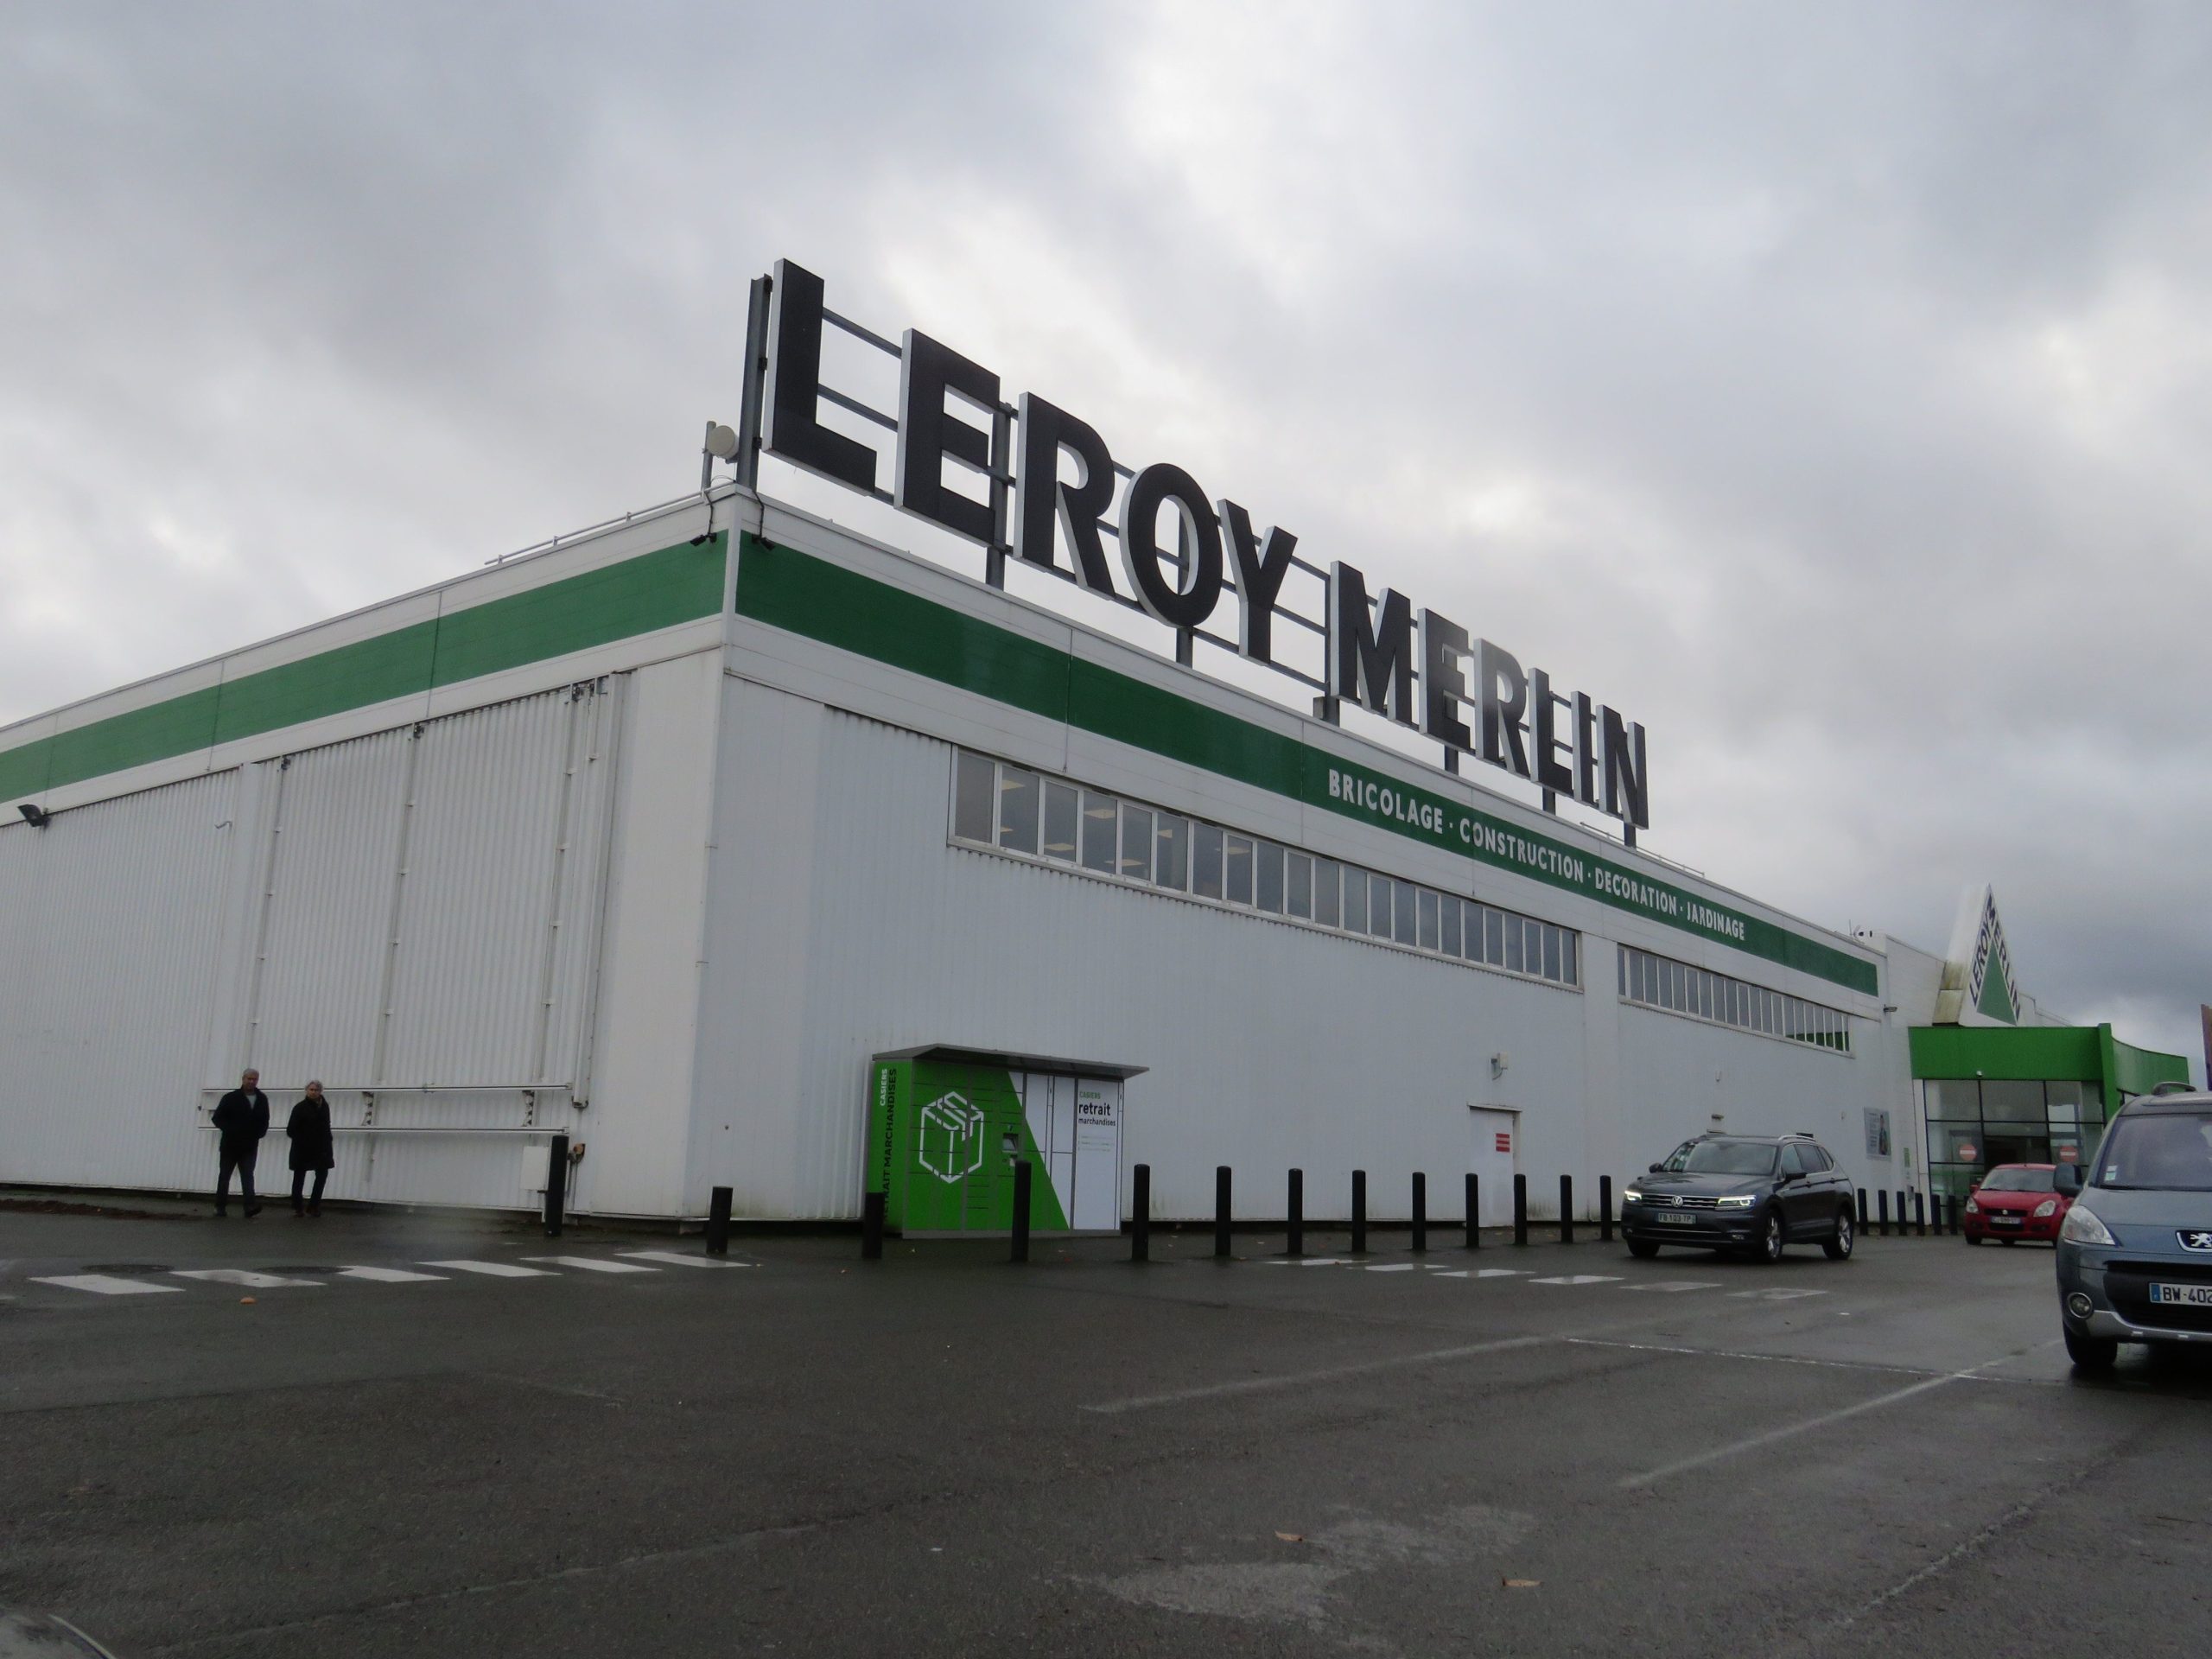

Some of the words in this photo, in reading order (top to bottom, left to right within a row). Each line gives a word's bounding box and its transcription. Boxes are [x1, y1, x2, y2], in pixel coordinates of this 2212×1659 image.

[762, 257, 1298, 665] LEROY
[1330, 560, 1649, 830] MERLIN
[1329, 769, 1443, 834] BRICOLAGE
[1460, 818, 1583, 883] CONSTRUCTION
[1595, 868, 1677, 917] DECORATION
[1687, 901, 1745, 941] JARDINAGE
[1969, 912, 1991, 1007] LEROY
[1987, 893, 2020, 1022] MERLIN
[884, 1068, 896, 1167] MARCHANDISES
[1078, 1102, 1111, 1116] retrait
